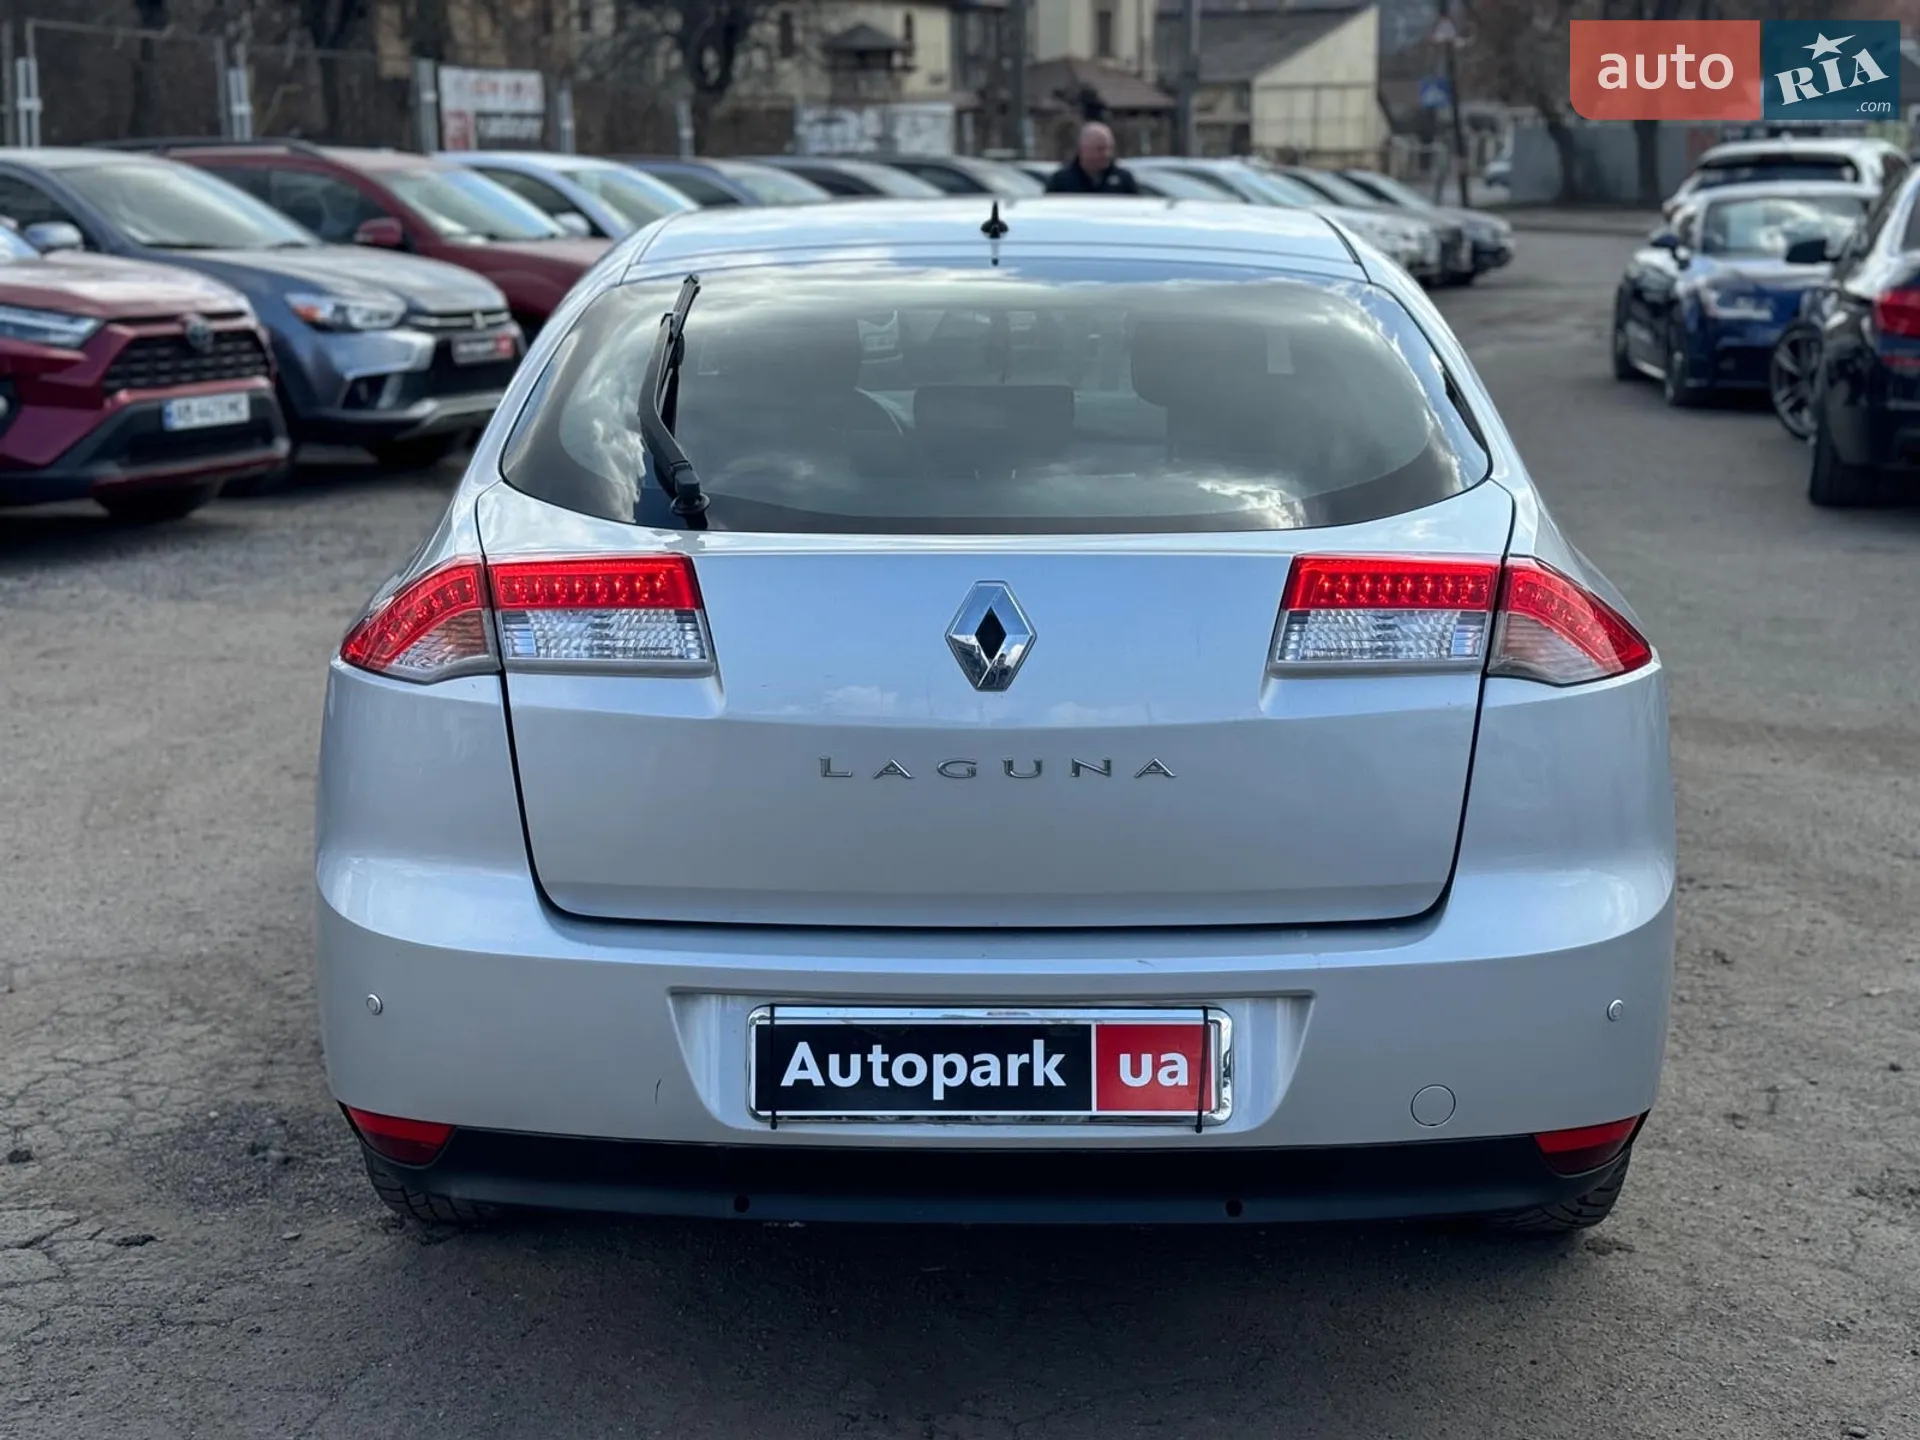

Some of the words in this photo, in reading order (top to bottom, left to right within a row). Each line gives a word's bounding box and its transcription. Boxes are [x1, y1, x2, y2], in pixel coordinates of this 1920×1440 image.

[818, 756, 1177, 779] LAGUNA
[780, 1039, 1066, 1100] Autopark
[1119, 1052, 1188, 1086] ua
